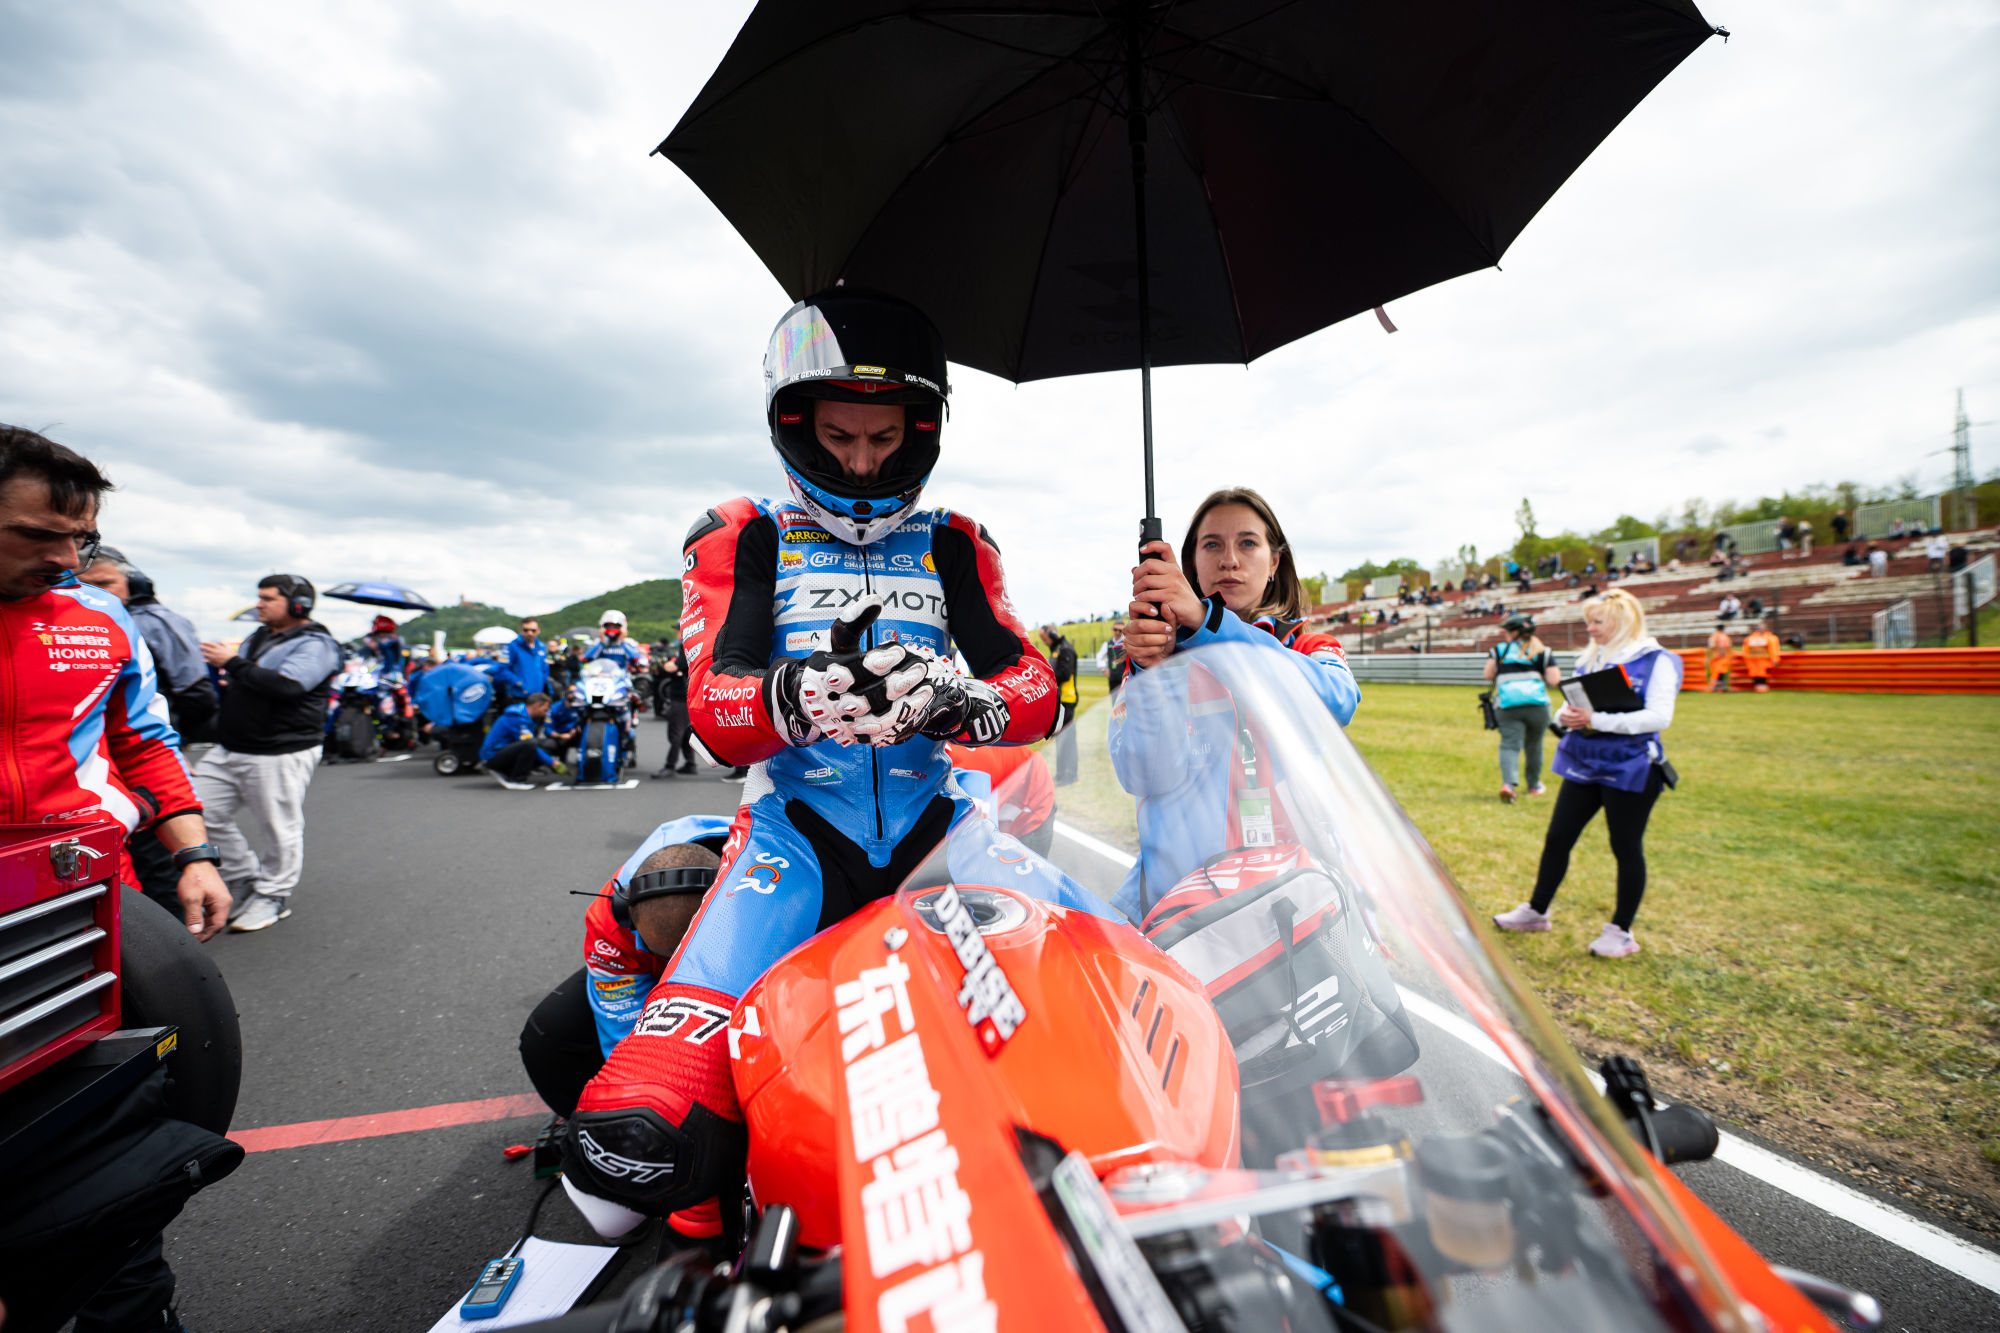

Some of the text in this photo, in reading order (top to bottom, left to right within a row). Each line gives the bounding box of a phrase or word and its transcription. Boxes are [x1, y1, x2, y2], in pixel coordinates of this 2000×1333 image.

[785, 531, 830, 541] ARROW
[48, 625, 109, 634] ZXMOTO
[48, 648, 110, 660] HONOR
[708, 687, 756, 702] ZXMOTO
[734, 852, 790, 895] SCR
[578, 1130, 675, 1184] RST
